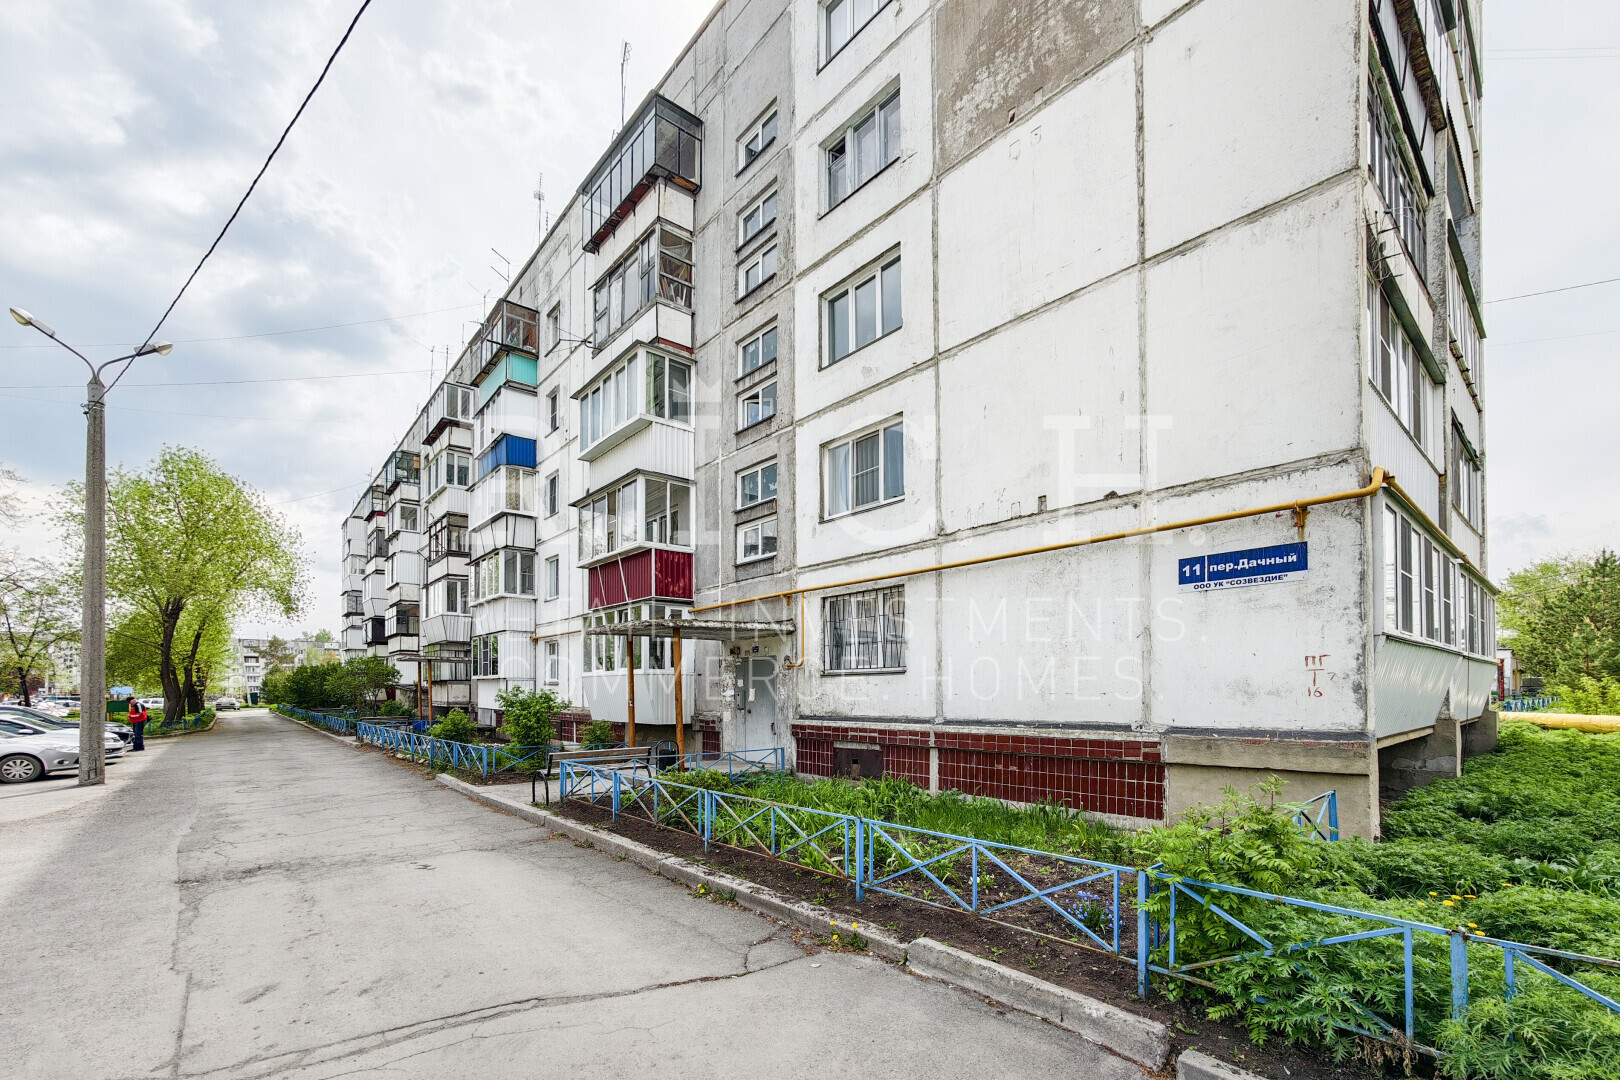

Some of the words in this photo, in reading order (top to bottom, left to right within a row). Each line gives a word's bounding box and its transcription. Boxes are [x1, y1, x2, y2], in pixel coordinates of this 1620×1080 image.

[1182, 563, 1201, 577] 11
[1209, 552, 1297, 573] пер.Дачный
[1193, 582, 1211, 590] ООО
[1213, 580, 1224, 588] УК
[1225, 573, 1289, 586] "СОЗВЕЗДИЕ"
